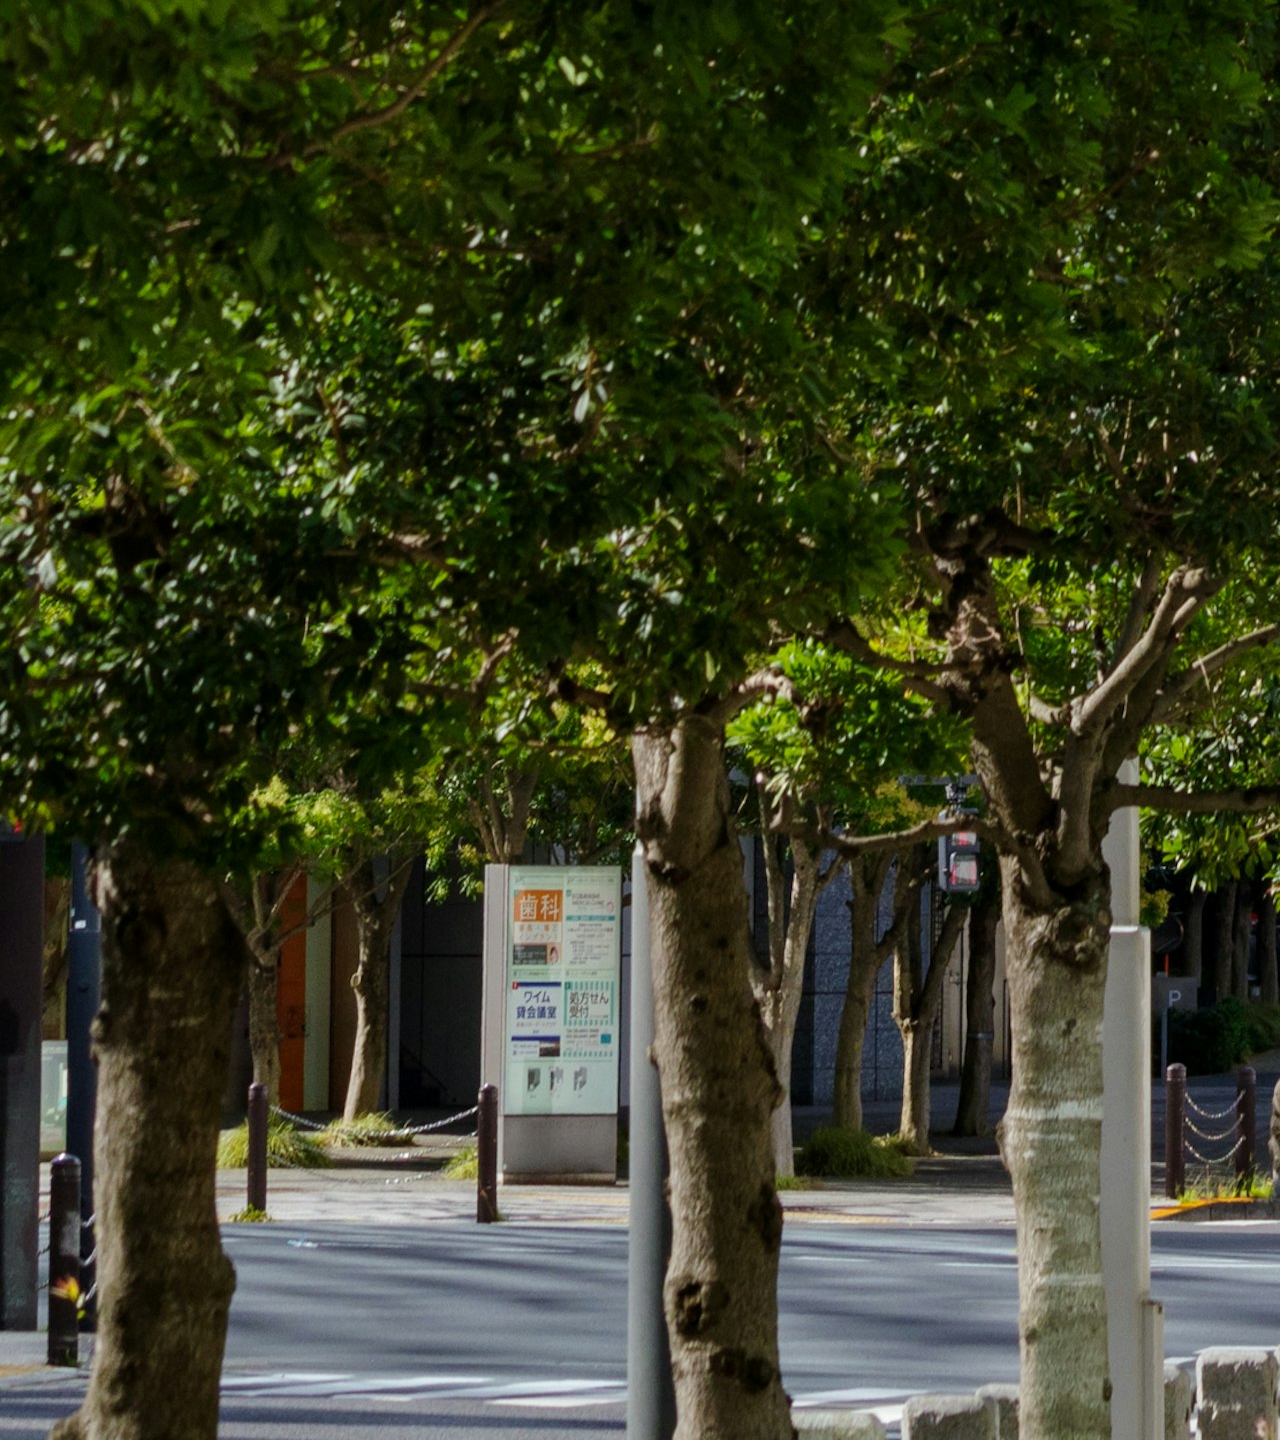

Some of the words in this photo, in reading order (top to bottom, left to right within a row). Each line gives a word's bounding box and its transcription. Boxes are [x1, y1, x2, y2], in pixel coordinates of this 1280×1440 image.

[520, 894, 560, 920] 歯科
[524, 991, 551, 1003] ワイム
[569, 992, 609, 1005] 処方せん
[1168, 990, 1182, 1006] P
[517, 1006, 557, 1019] 貸会議室
[569, 1006, 589, 1019] 受付
